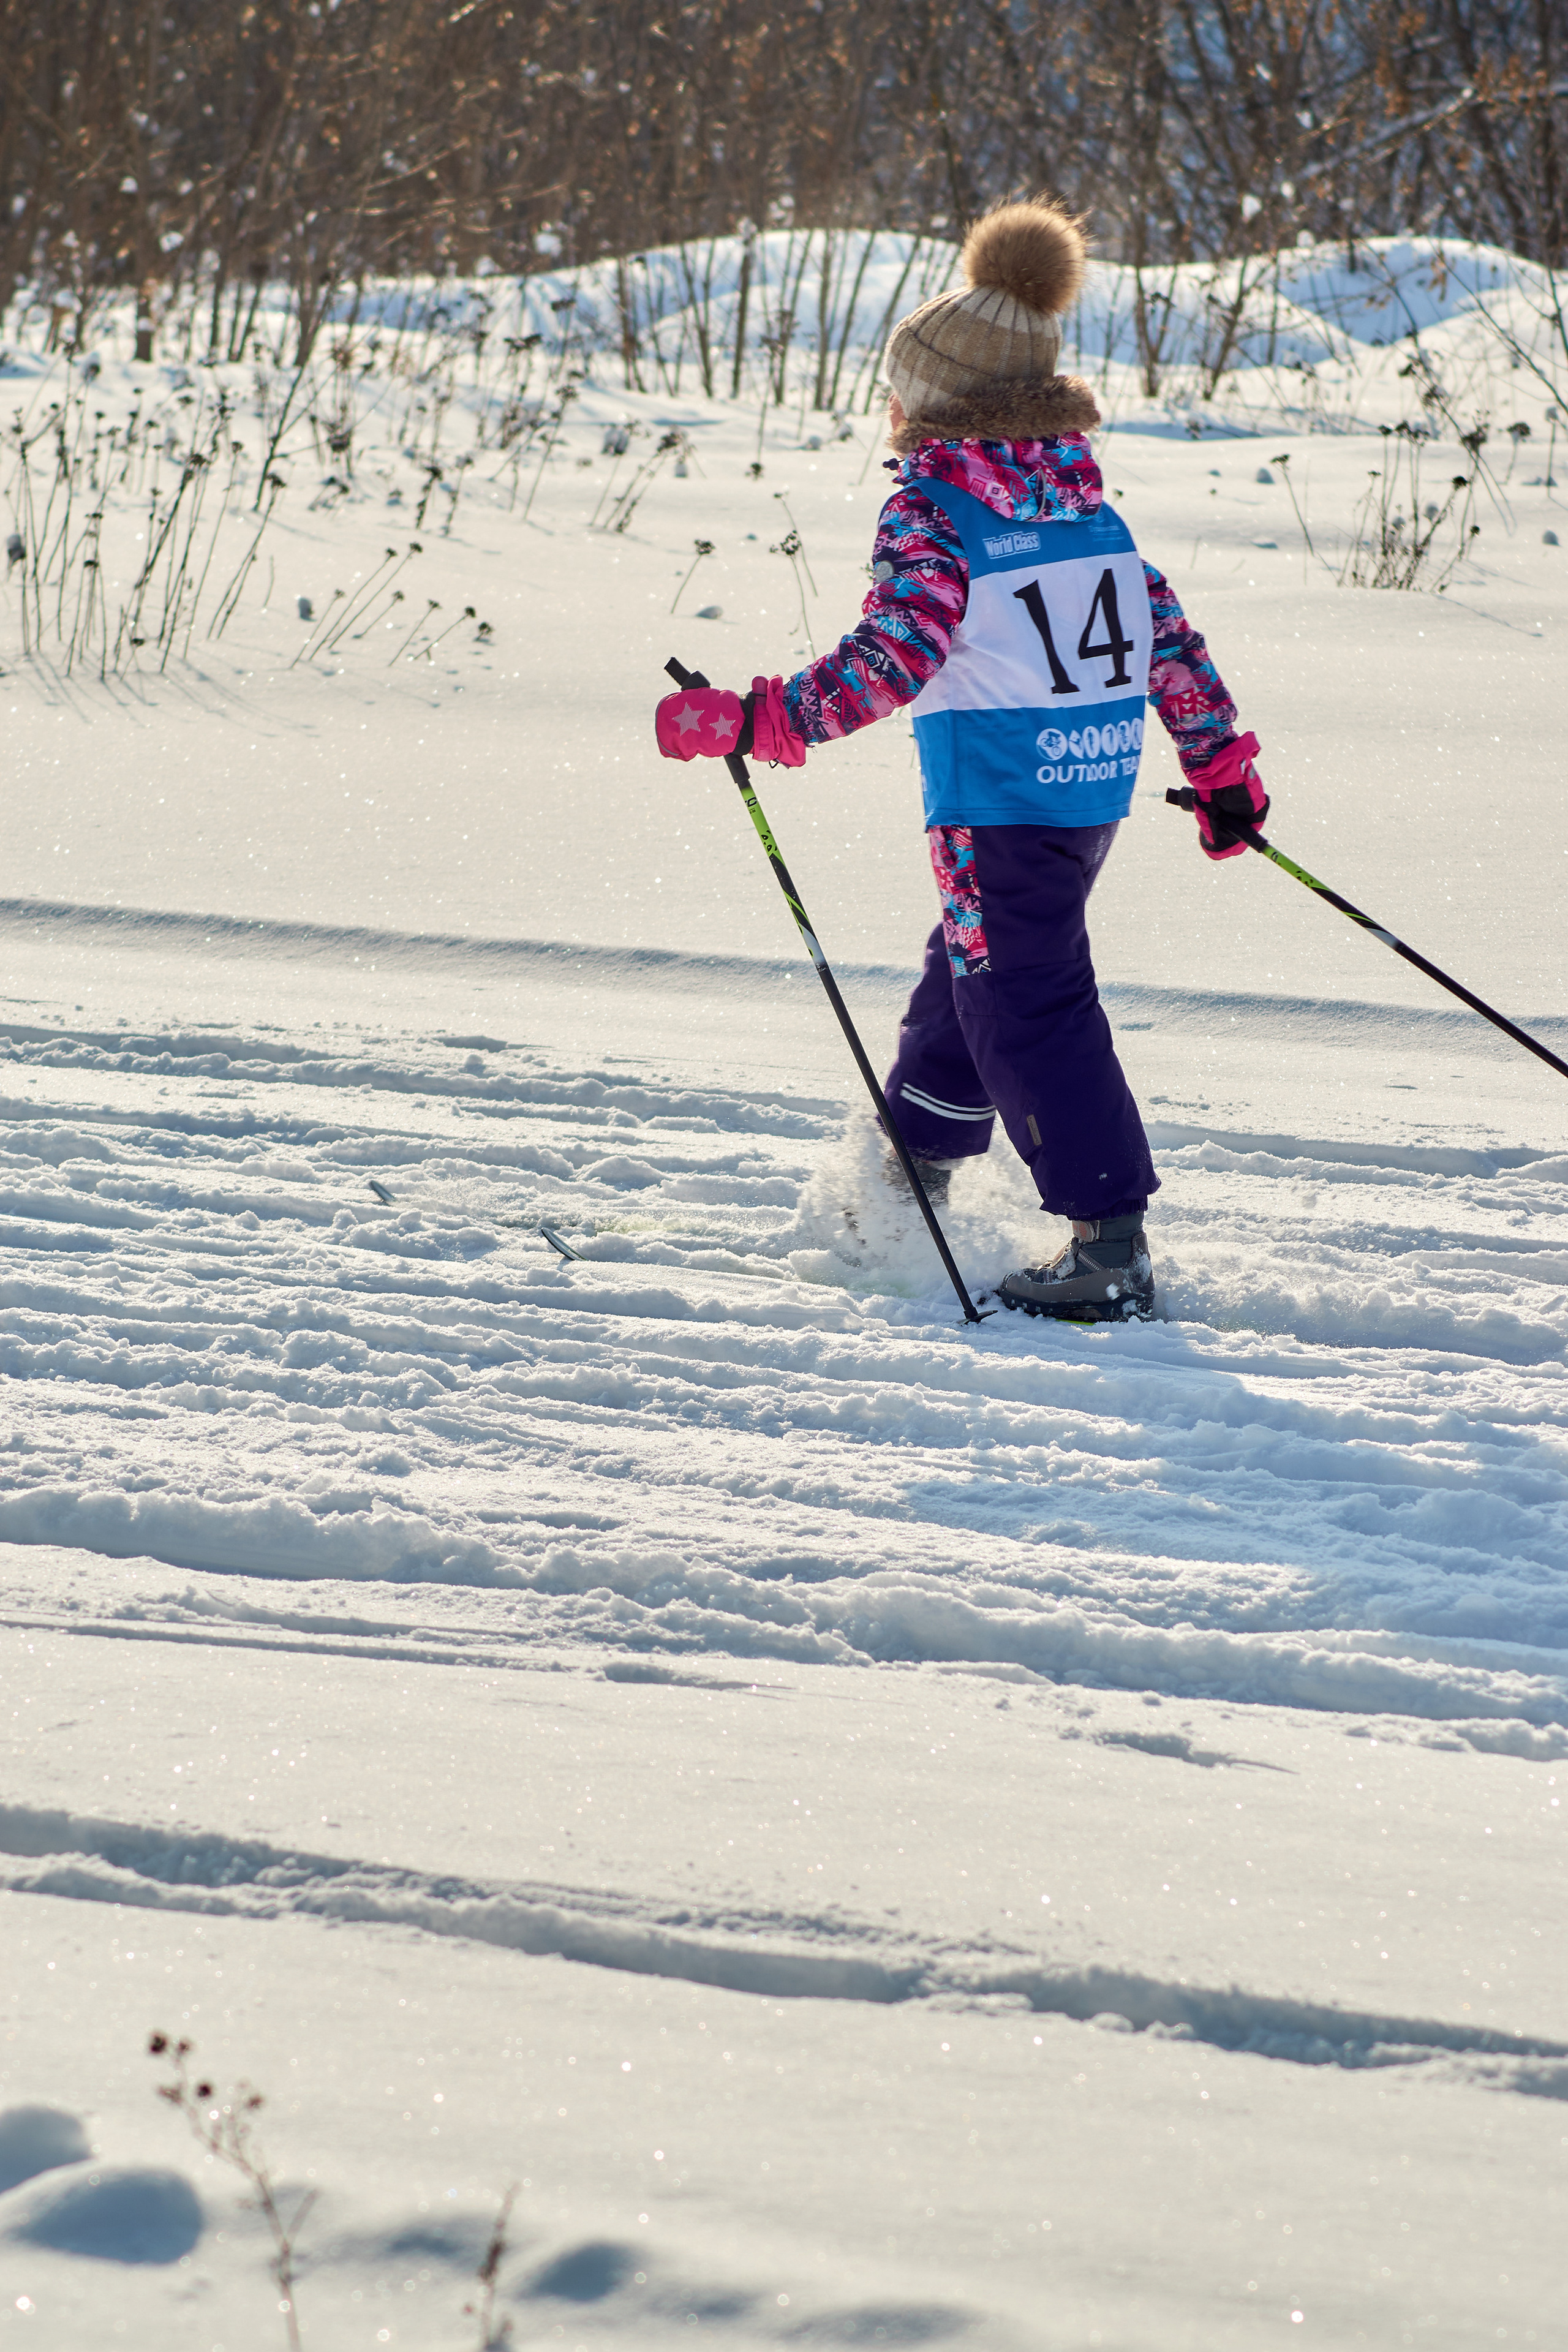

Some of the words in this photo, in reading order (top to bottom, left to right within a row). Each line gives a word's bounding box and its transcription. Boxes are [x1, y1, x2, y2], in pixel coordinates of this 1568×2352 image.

[984, 536, 1013, 556] World
[1013, 533, 1039, 551] Class
[1012, 568, 1134, 694] 14
